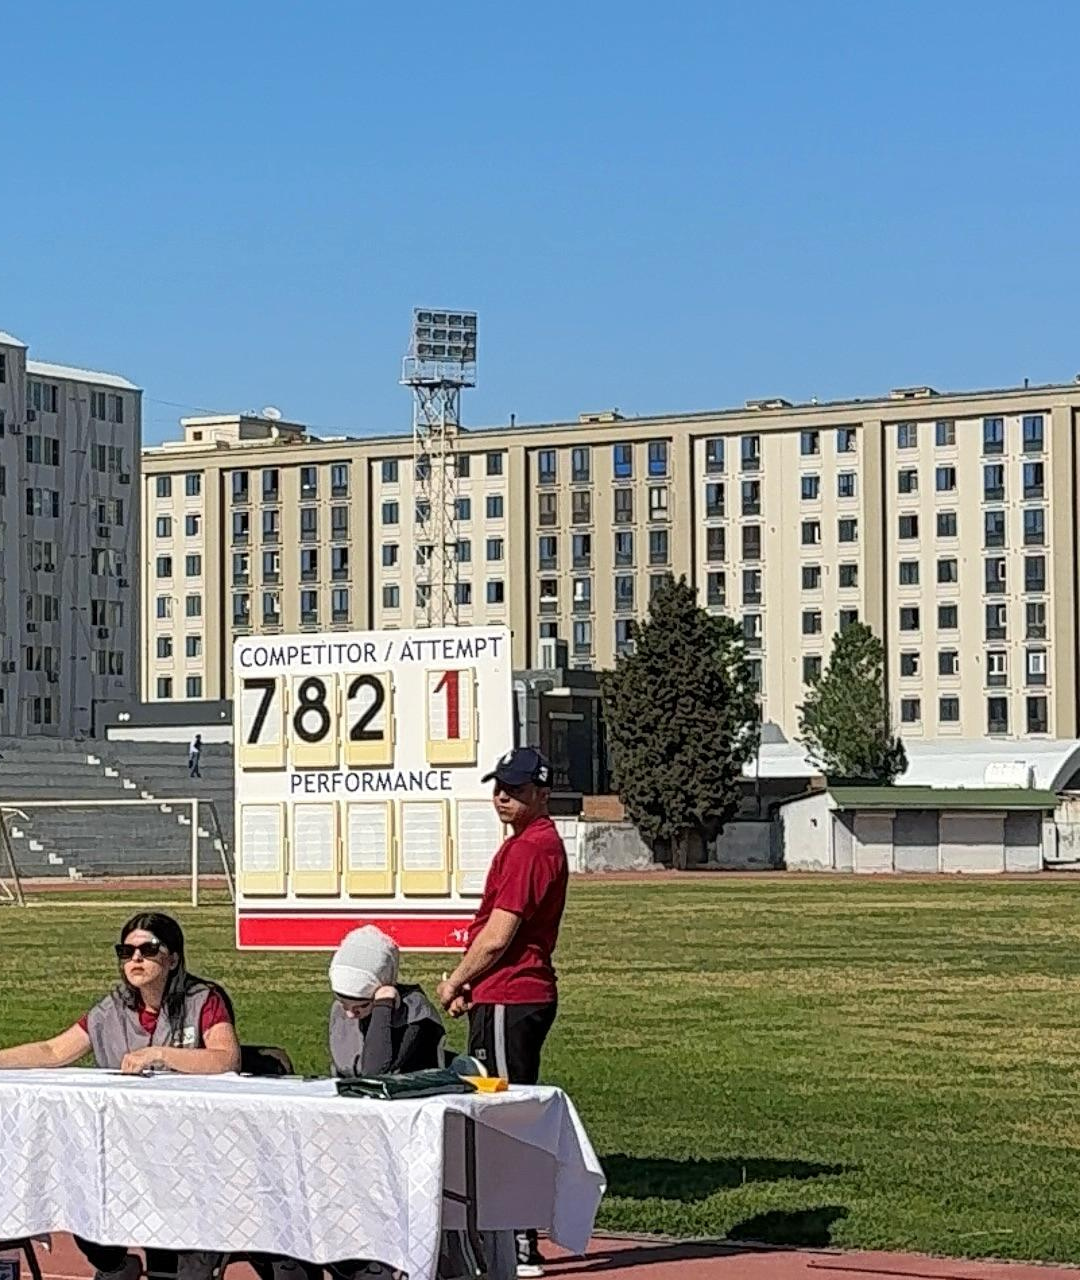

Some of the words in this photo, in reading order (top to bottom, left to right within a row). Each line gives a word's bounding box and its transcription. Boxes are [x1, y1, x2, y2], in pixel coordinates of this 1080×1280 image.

[240, 643, 377, 667] COMPETITOR
[384, 641, 394, 662] /
[400, 636, 503, 661] ATTEMPT
[243, 673, 386, 744] 782
[433, 670, 460, 739] 1
[291, 771, 453, 794] PERFORMANCE
